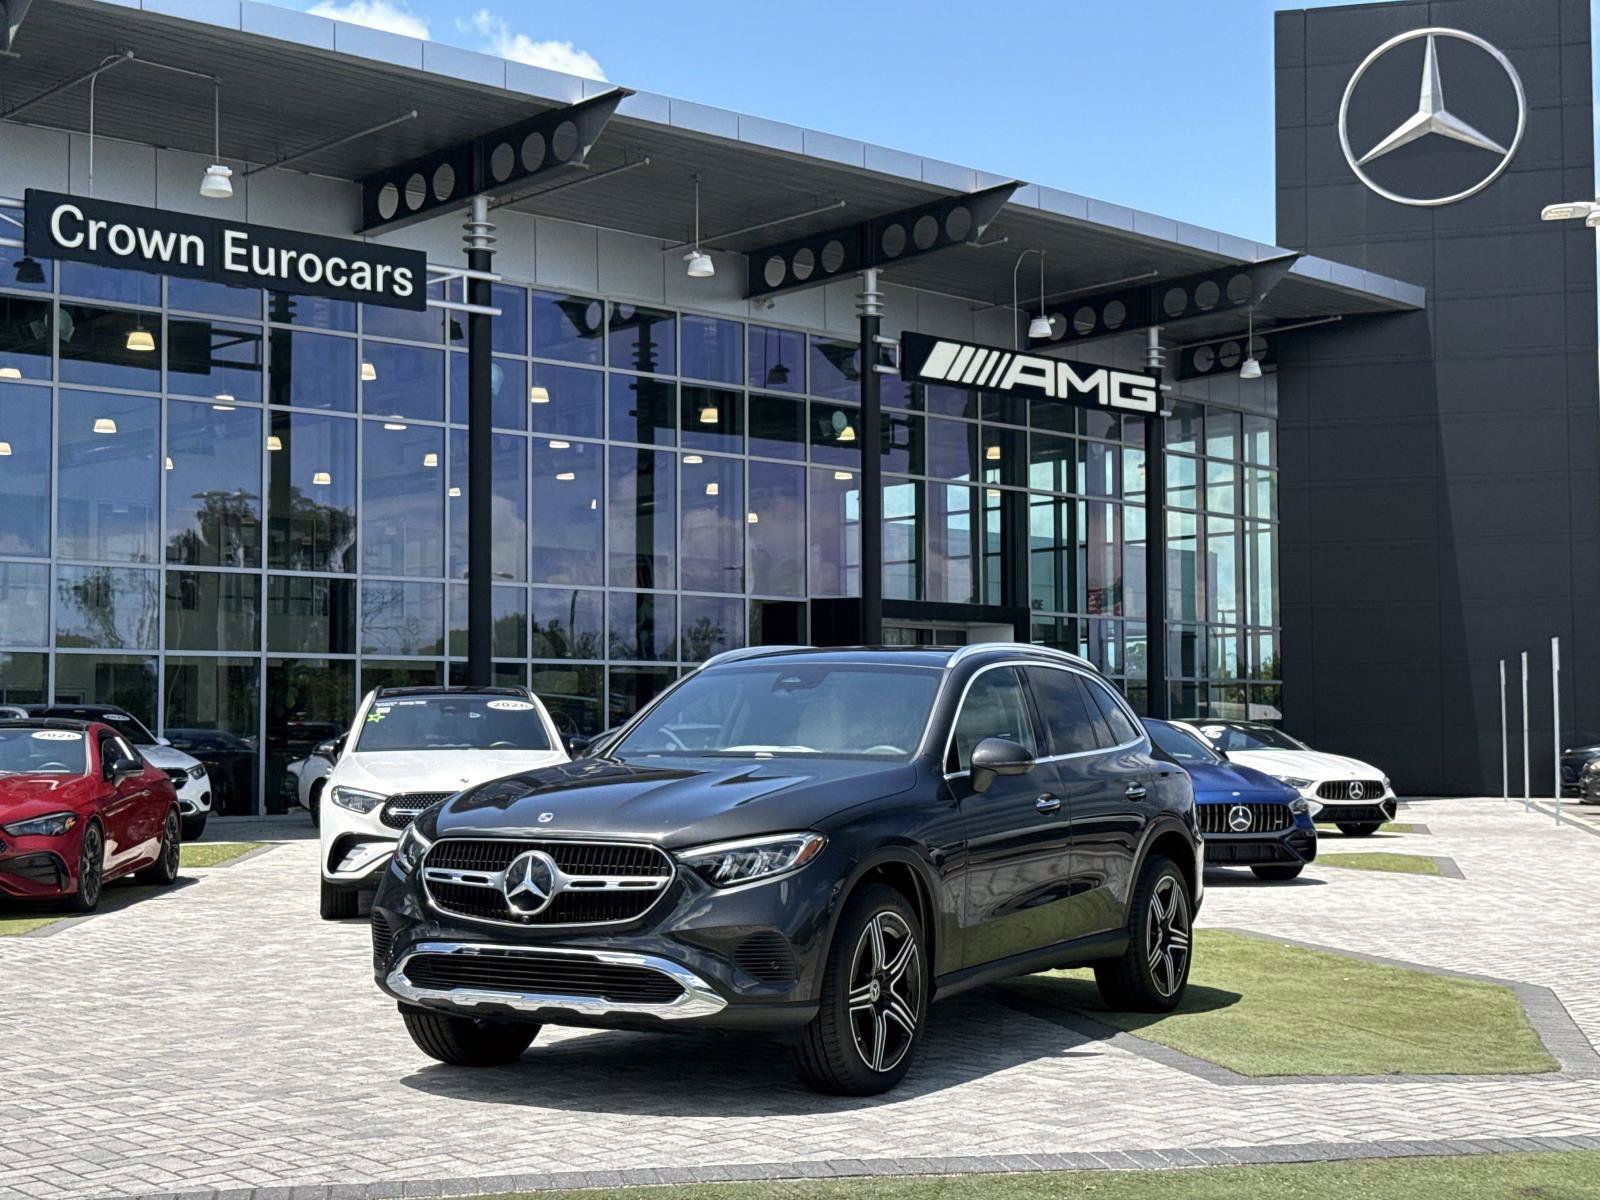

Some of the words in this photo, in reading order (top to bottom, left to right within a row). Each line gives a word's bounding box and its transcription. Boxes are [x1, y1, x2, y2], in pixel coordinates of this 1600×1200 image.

[50, 203, 205, 266] Crown
[223, 229, 414, 297] Eurocars
[1000, 354, 1157, 413] AMG
